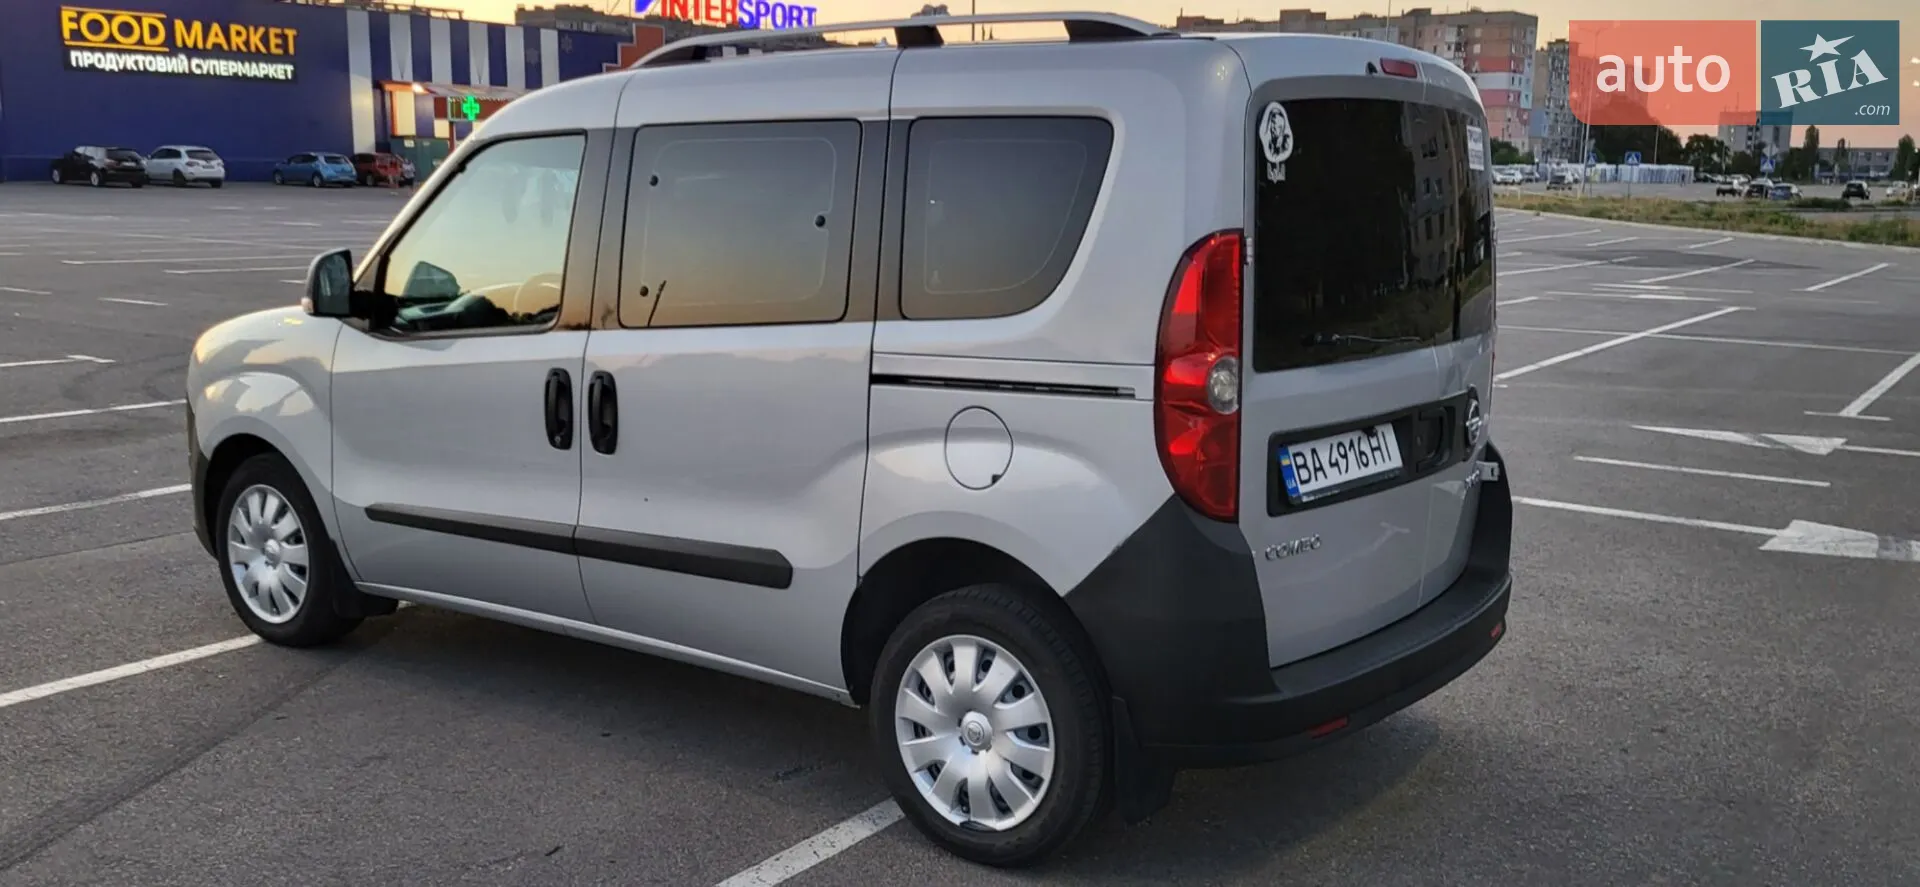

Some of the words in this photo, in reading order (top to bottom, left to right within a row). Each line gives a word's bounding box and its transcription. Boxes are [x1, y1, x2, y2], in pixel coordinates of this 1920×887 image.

[61, 10, 166, 45] FOOD
[174, 18, 297, 55] MARKET
[70, 50, 190, 75] ПРОДУКТОВИЙ
[191, 60, 294, 80] СУПЕРМАРКЕТ
